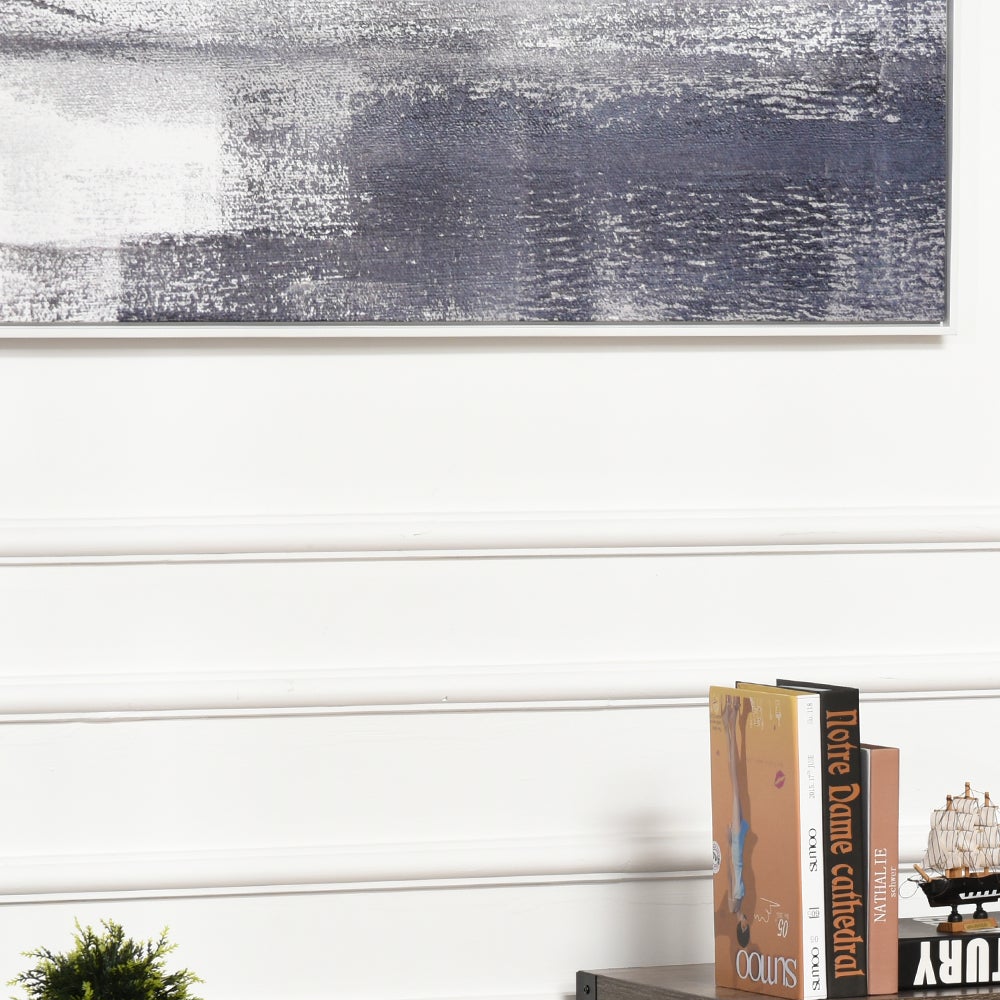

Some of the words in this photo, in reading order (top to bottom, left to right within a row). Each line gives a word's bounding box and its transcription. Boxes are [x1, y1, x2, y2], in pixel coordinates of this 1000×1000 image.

[826, 709, 858, 775] Notre
[808, 827, 818, 872] sumoo
[828, 783, 861, 855] Dame
[873, 847, 887, 923] NATHALIE
[831, 863, 866, 979] cathedral
[735, 949, 797, 989] sumoo
[811, 946, 821, 991] sumoo
